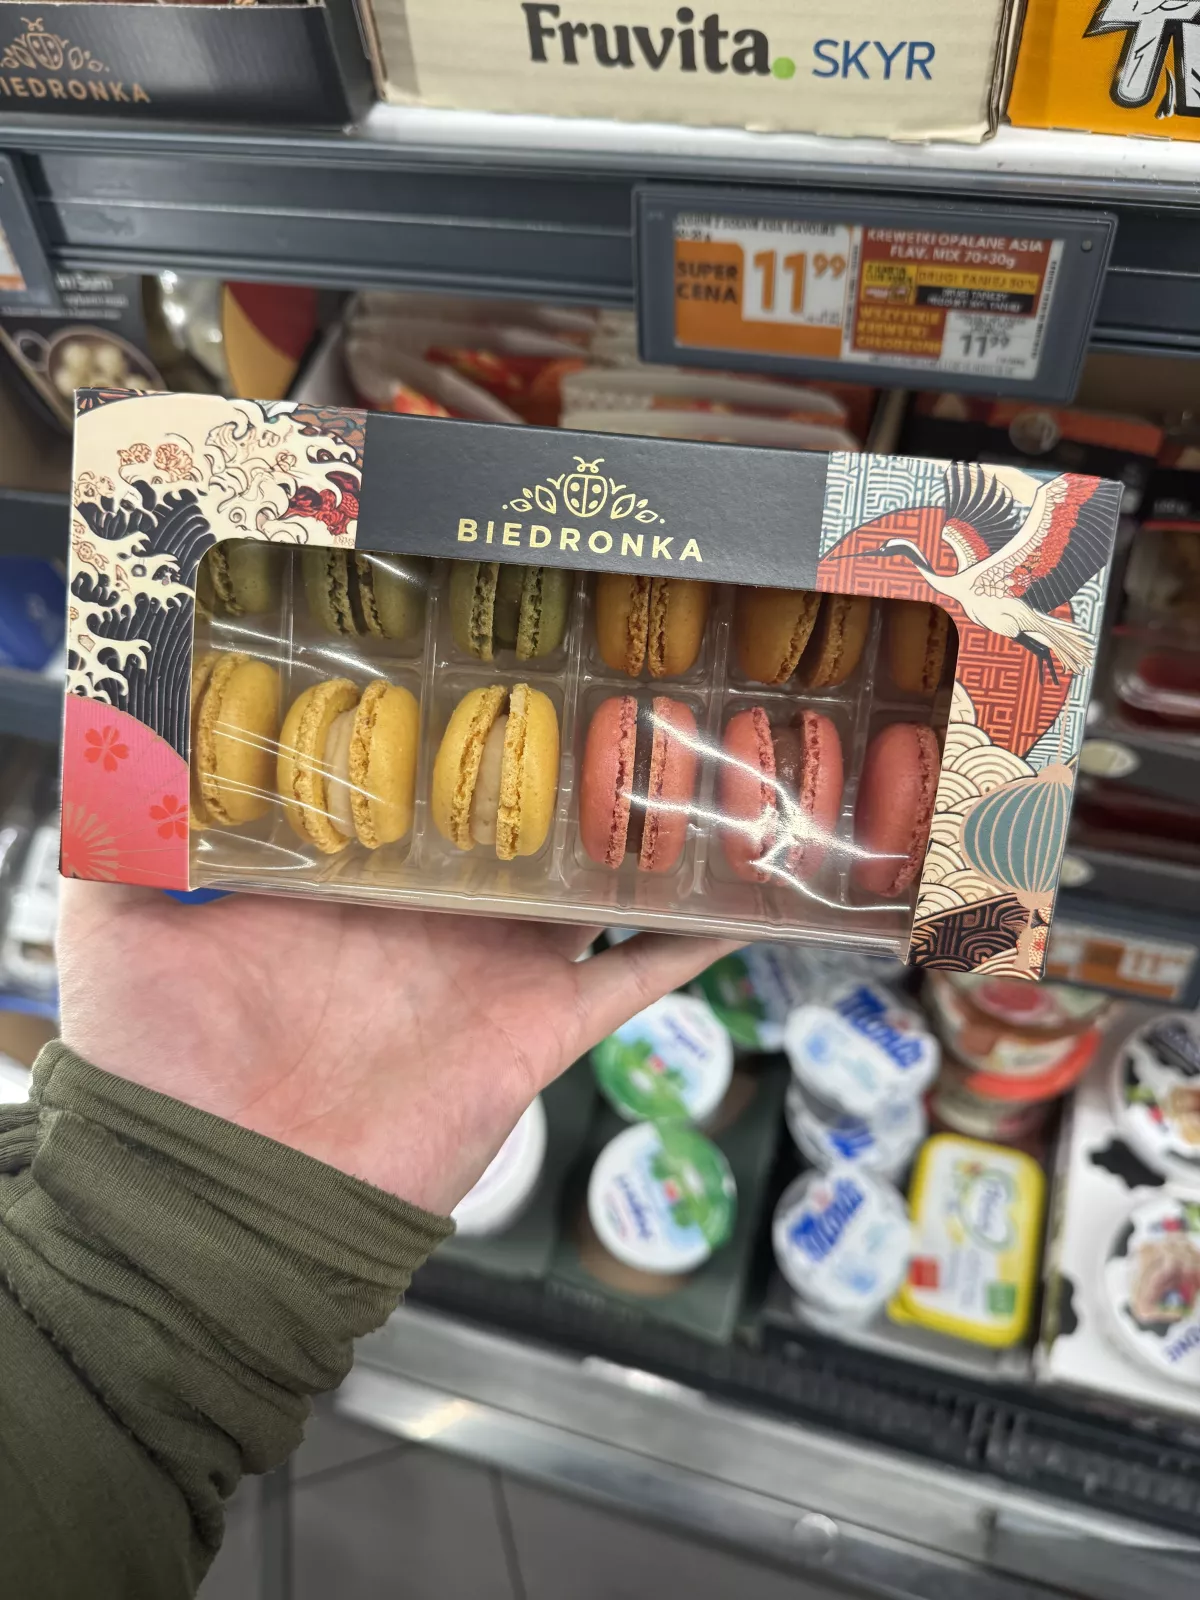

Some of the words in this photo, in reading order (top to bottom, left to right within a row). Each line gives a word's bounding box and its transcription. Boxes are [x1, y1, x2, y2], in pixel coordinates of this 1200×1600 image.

[812, 38, 936, 81] SKYR
[0, 76, 152, 104] IEDRONKA
[867, 229, 936, 246] KREWETKI
[937, 235, 1006, 251] OPALANE
[1008, 240, 1044, 254] ASIA
[889, 245, 929, 260] FLAV.
[932, 248, 962, 263] MIX
[676, 261, 738, 281] SUPER
[676, 282, 738, 304] CENA
[457, 517, 704, 564] BIEDRONKA
